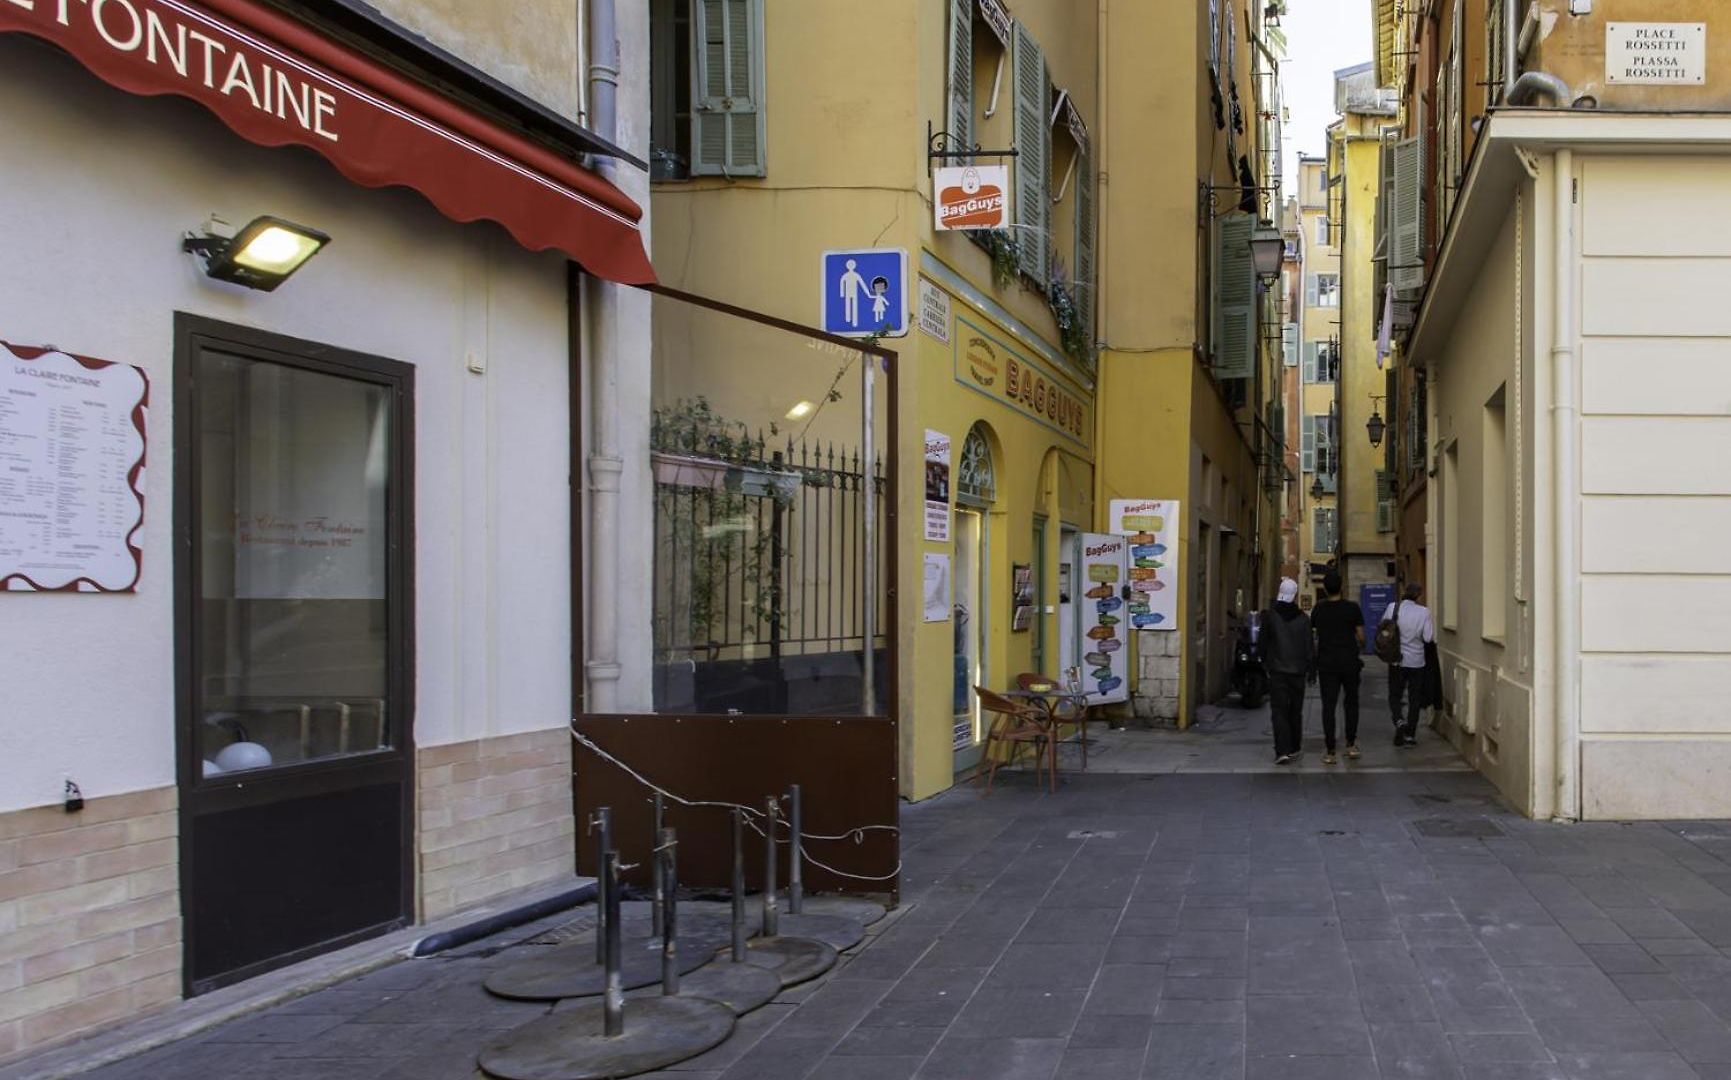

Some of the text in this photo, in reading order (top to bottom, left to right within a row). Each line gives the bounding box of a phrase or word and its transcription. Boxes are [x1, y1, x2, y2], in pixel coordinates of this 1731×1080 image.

[1636, 29, 1674, 38] PLACE
[1625, 41, 1686, 50] ROSSETTI
[1633, 57, 1678, 66] PLASSA
[1625, 68, 1685, 78] ROSSETTI
[940, 196, 1003, 217] BagGuys
[1005, 358, 1082, 436] BAGGUYS
[1124, 503, 1161, 513] BagGuys
[1086, 542, 1121, 556] BagGuys
